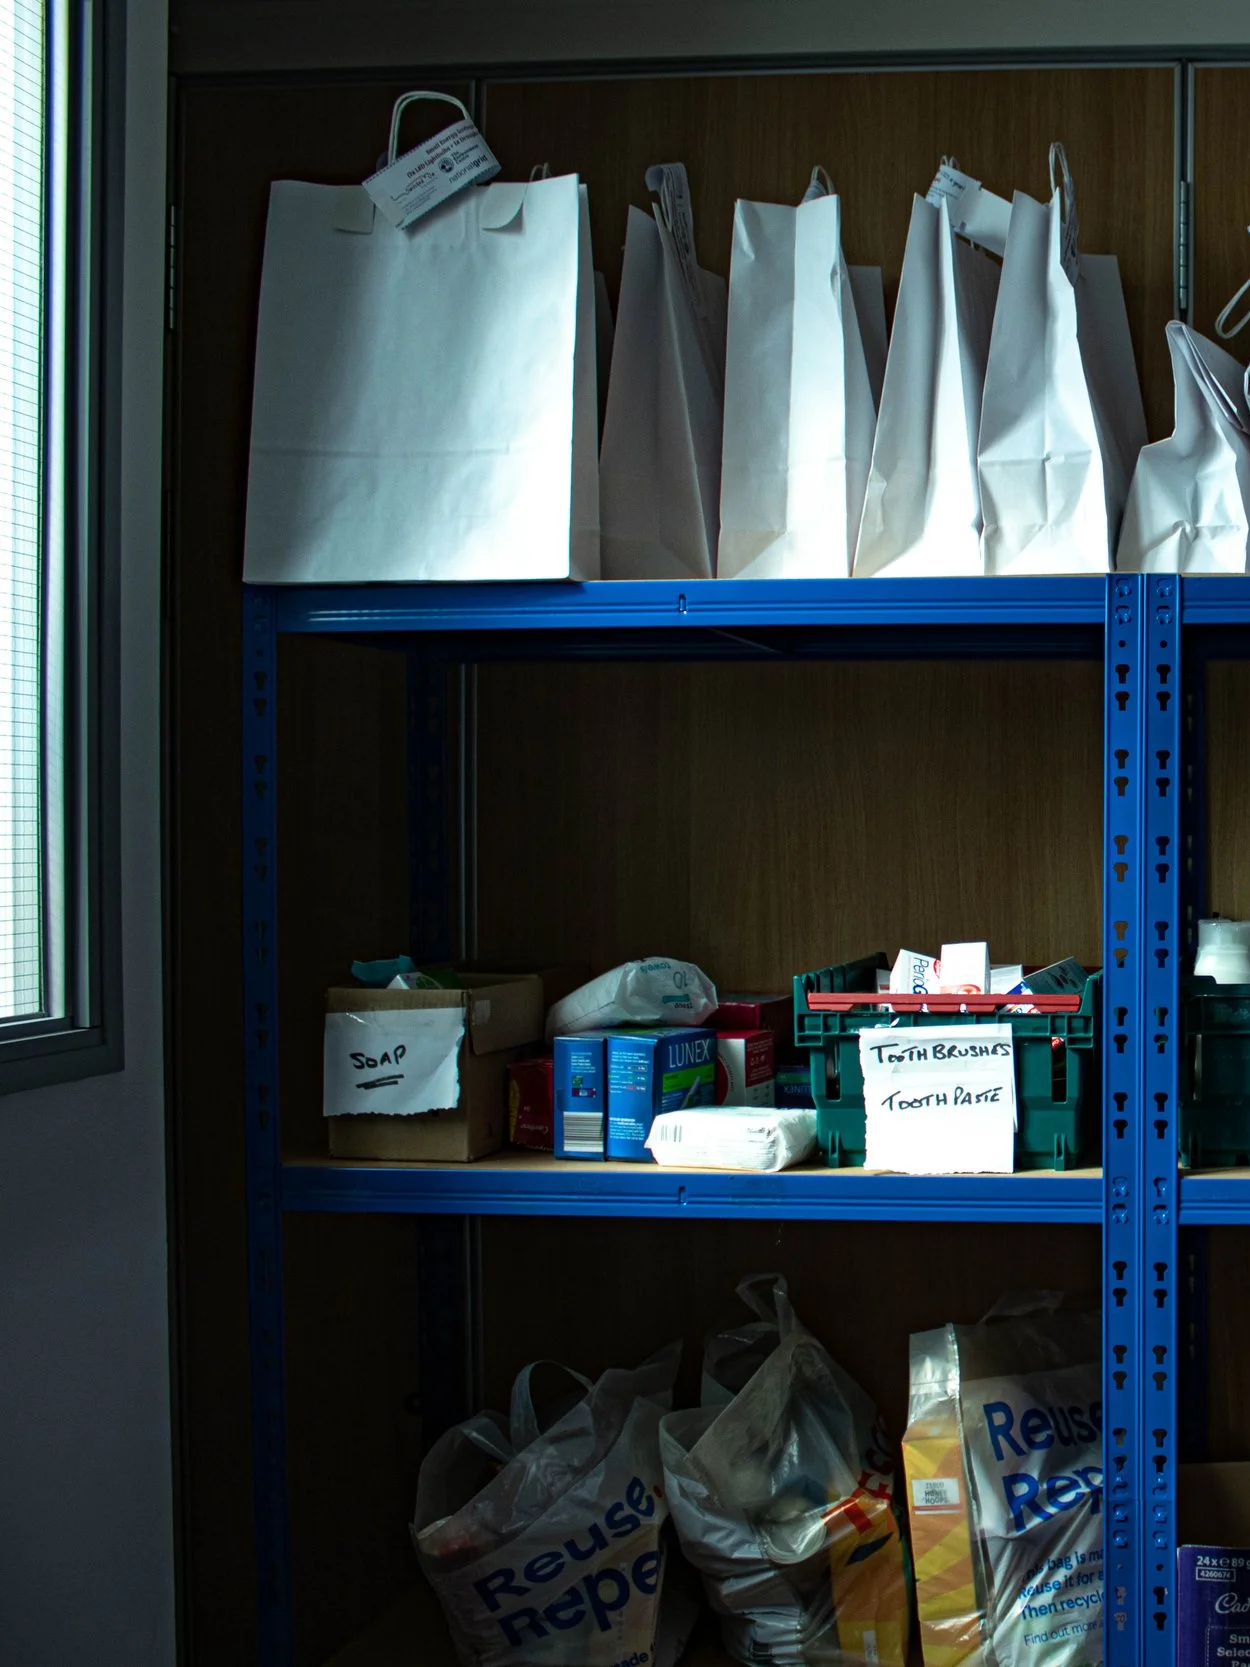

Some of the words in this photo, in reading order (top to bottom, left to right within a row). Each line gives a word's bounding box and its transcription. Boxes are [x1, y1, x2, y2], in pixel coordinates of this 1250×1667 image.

[448, 154, 489, 184] nationalgrid
[639, 961, 671, 973] towels
[912, 956, 930, 995] PerioG
[672, 971, 688, 989] 10
[350, 1044, 406, 1069] SOAP
[668, 1038, 711, 1068] LUNEX
[1002, 1466, 1104, 1532] Rep
[1047, 1555, 1073, 1571] bag
[1075, 1551, 1086, 1565] is
[1064, 1574, 1074, 1588] it
[1077, 1571, 1096, 1586] for
[498, 1551, 661, 1646] Repe
[1022, 1602, 1058, 1620] Then
[1024, 1631, 1049, 1647] Find
[1050, 1627, 1069, 1640] out
